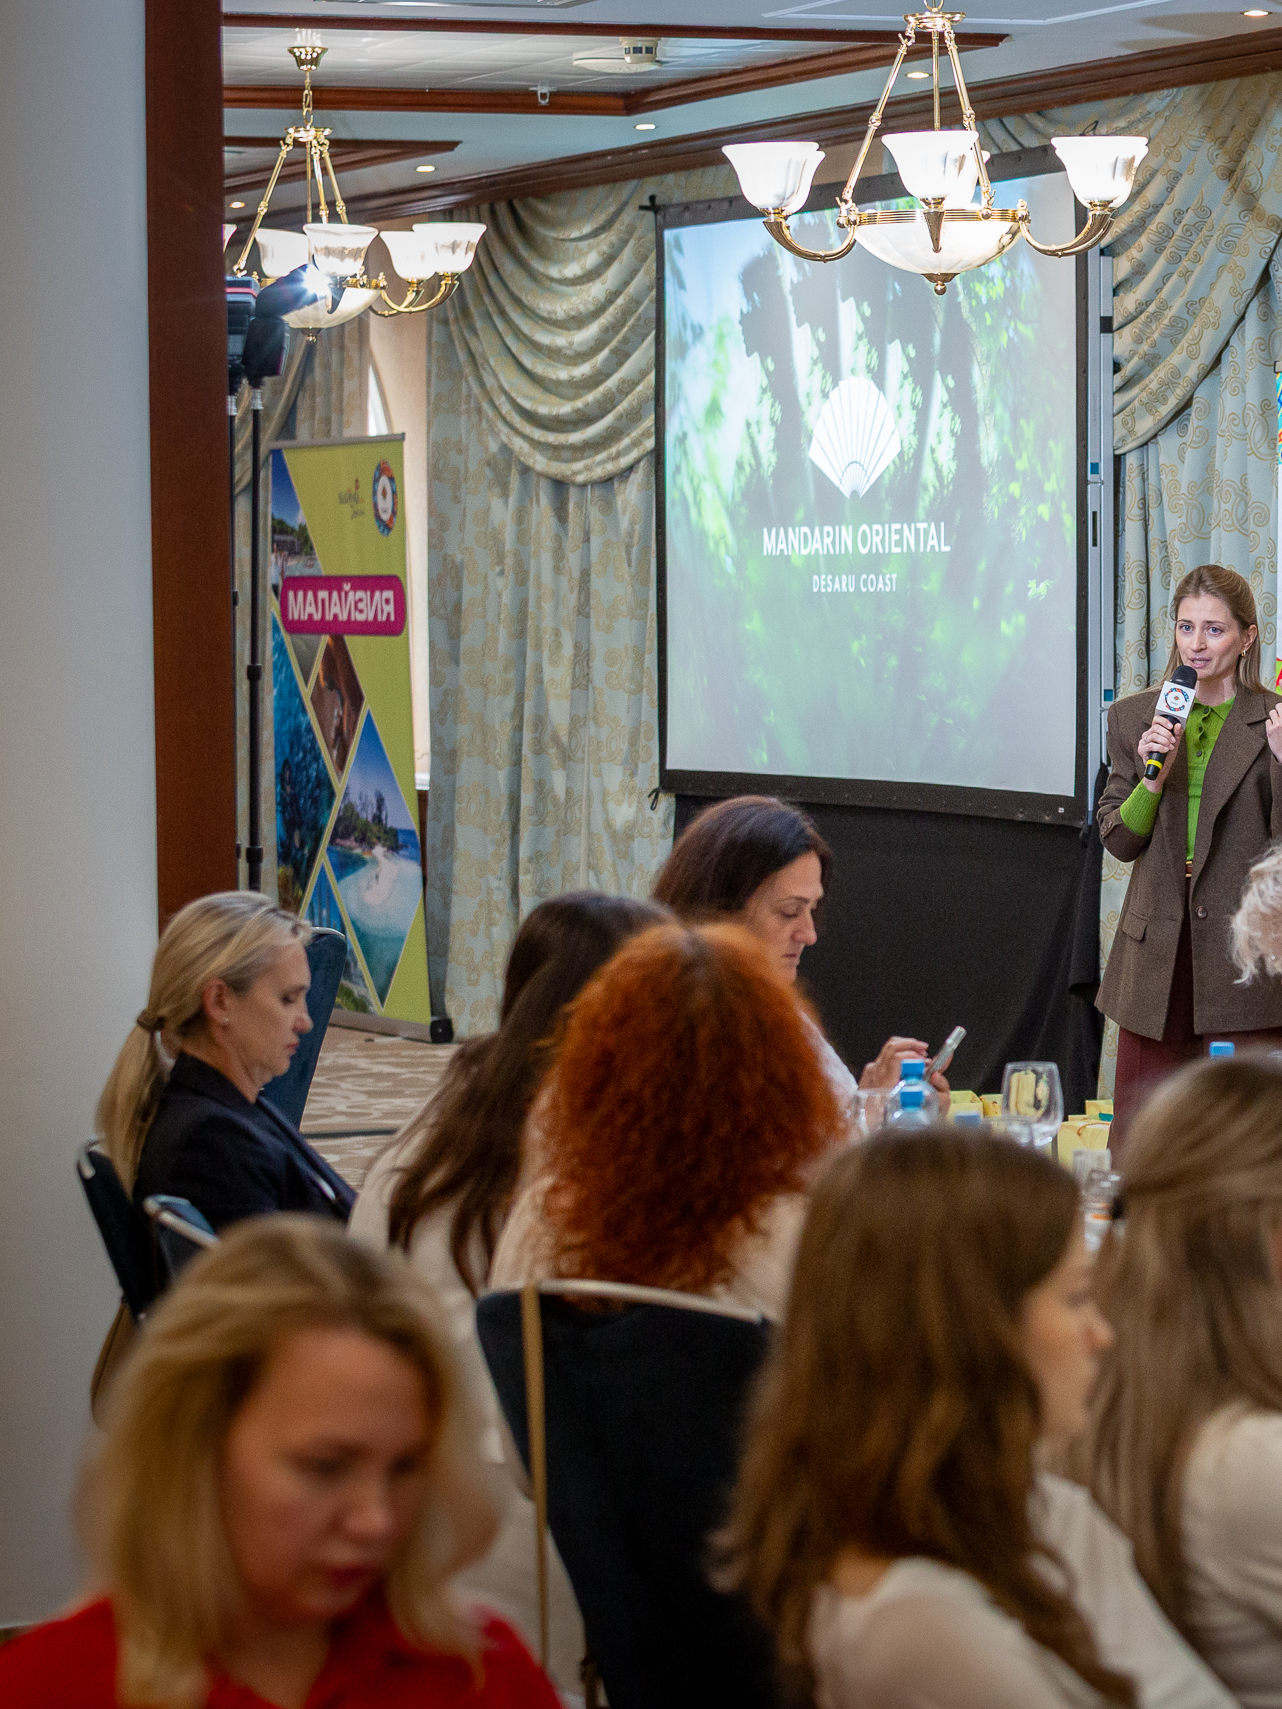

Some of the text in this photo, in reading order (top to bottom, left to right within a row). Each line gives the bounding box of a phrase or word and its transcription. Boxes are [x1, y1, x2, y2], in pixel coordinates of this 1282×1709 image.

[762, 521, 951, 556] MANDARIN ORIENTAL
[812, 573, 898, 593] DESARU COAST
[287, 581, 395, 622] МАЛАЙЗИЯ
